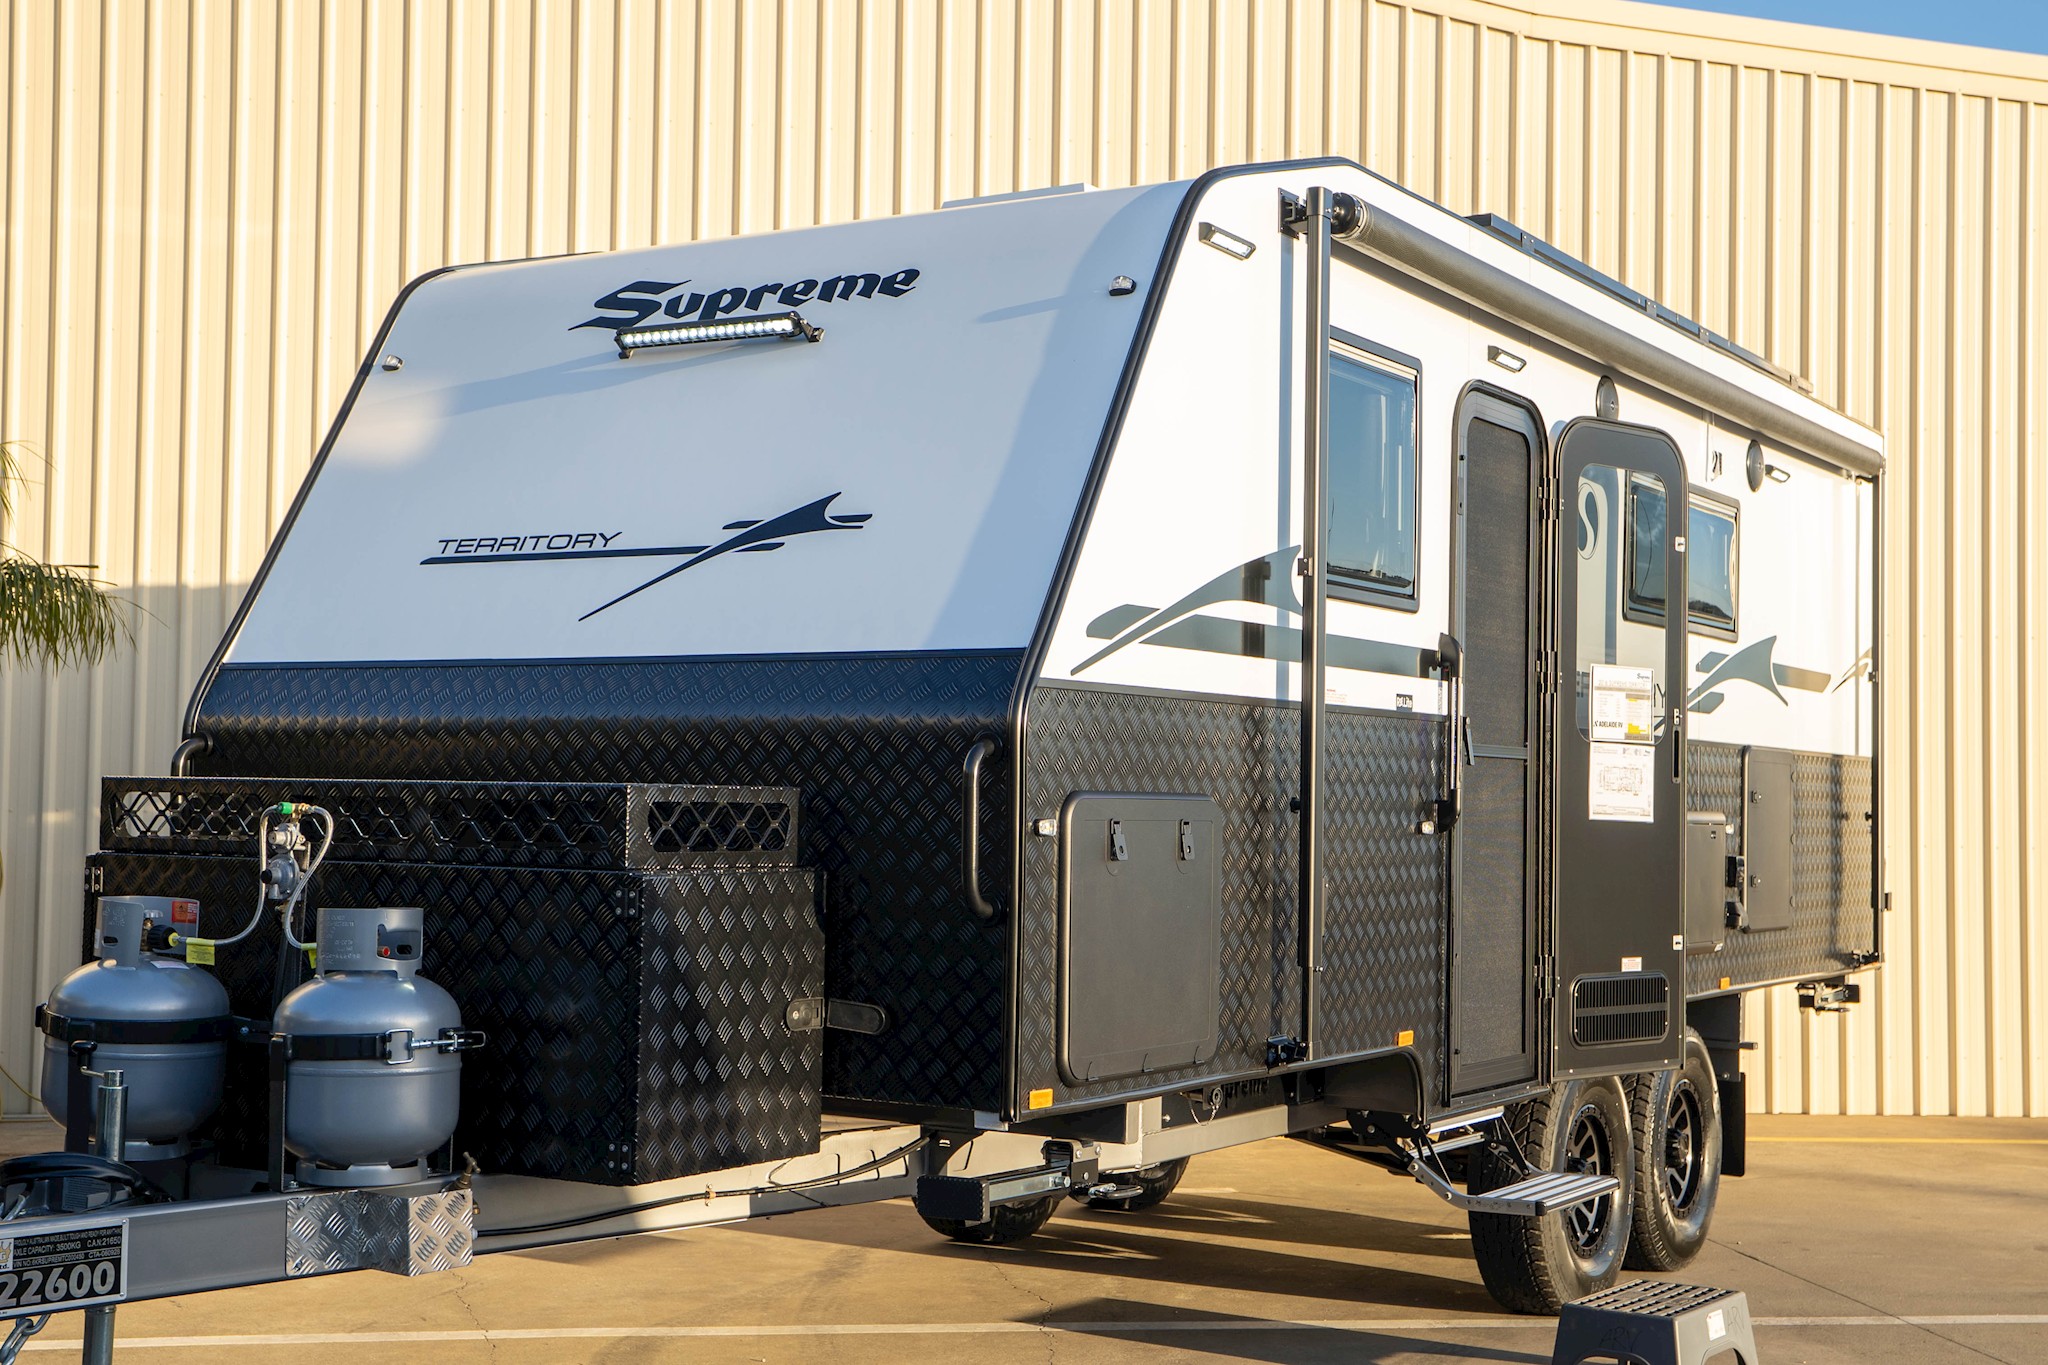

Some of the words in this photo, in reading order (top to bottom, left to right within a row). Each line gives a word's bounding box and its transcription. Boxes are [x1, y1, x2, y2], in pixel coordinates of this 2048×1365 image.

[567, 268, 921, 331] Supreme
[438, 532, 623, 554] TERRITORY
[14, 1246, 27, 1256] AXLE
[56, 1240, 81, 1251] 3500KG
[0, 1261, 116, 1308] 22600
